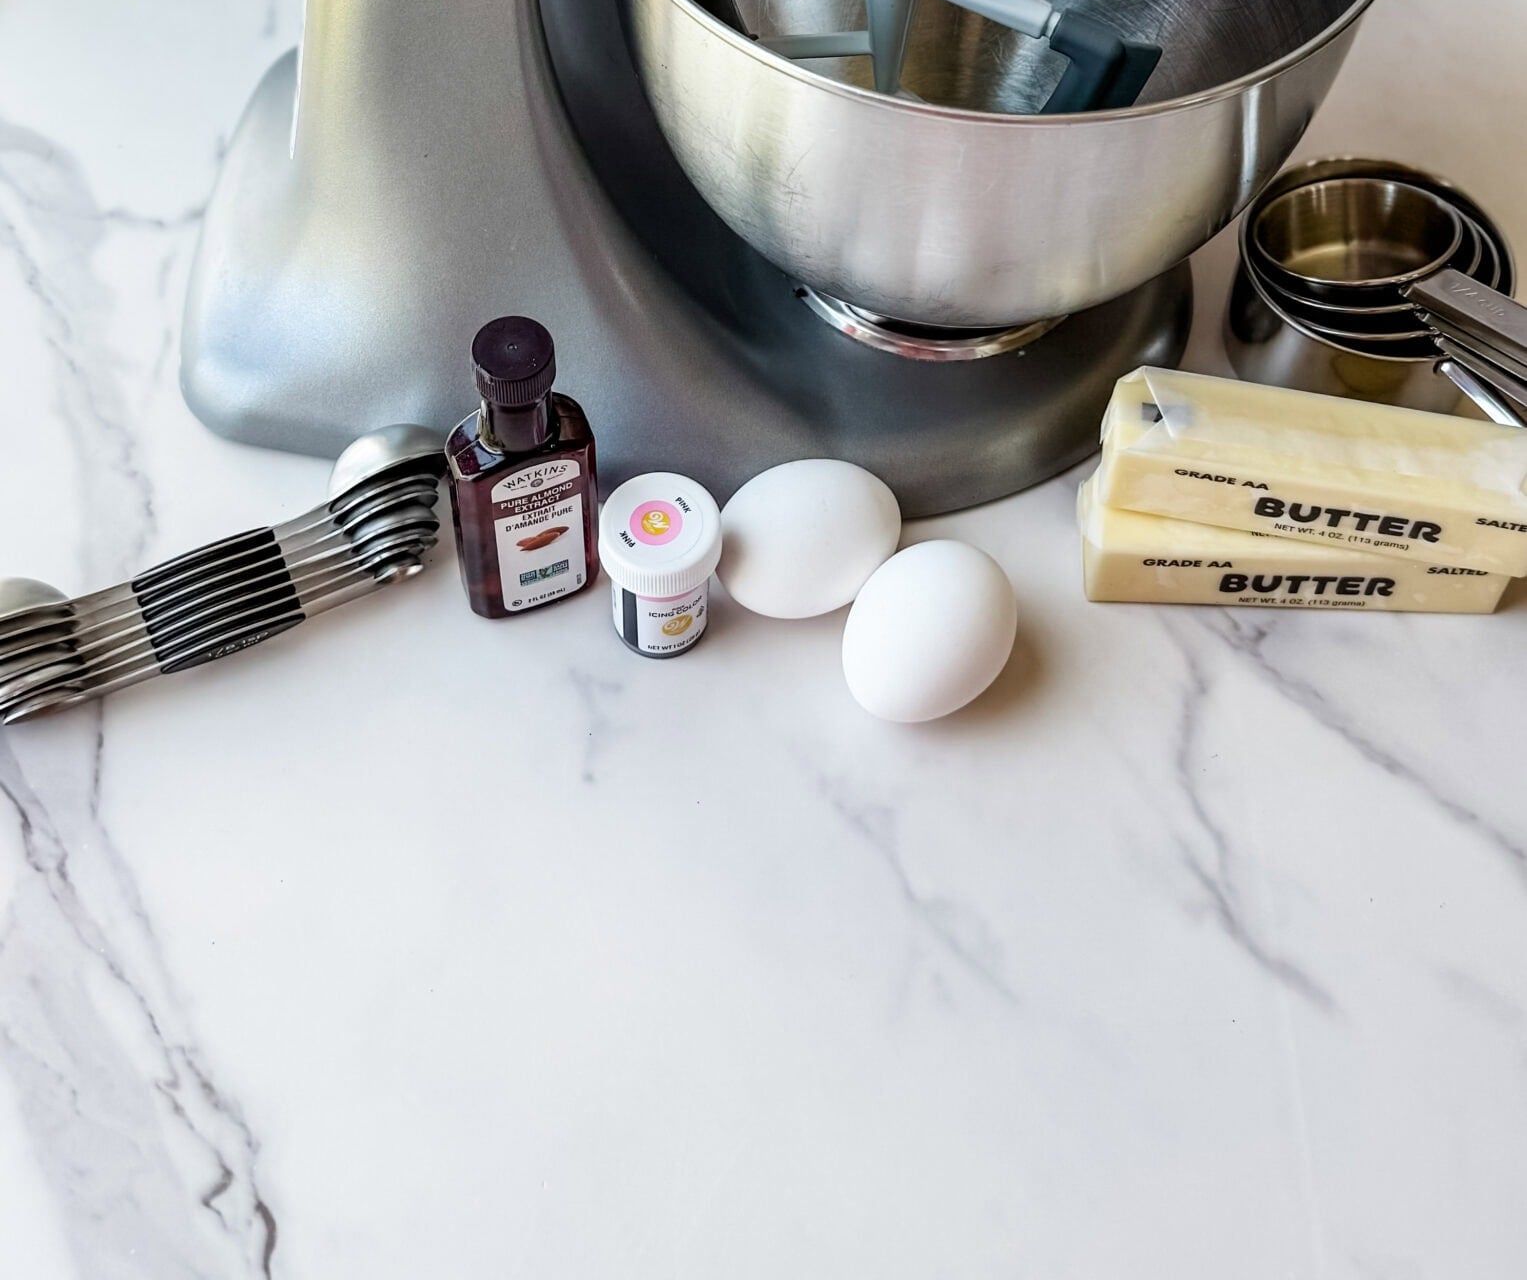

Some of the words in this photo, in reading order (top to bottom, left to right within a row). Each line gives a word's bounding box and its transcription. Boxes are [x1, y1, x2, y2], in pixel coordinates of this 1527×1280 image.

[503, 465, 568, 489] WATKINS
[1174, 468, 1236, 485] GRADE
[1241, 479, 1269, 491] AA
[500, 496, 529, 510] PURE
[530, 481, 573, 502] ALMOND
[515, 493, 561, 513] EXTRACT
[675, 496, 692, 514] PINK
[505, 514, 551, 532] D'AMANDE
[551, 505, 573, 519] PURE
[522, 505, 556, 520] EXTRAIT
[1253, 496, 1442, 544] BUTTER
[619, 530, 636, 548] PINK
[1273, 522, 1295, 533] NET
[1297, 526, 1315, 536] WT.
[1347, 535, 1371, 544] (113
[1373, 539, 1410, 551] grams)
[1142, 558, 1204, 569] GRADE
[1207, 559, 1233, 569] AA
[1427, 566, 1489, 576] SALTED
[1219, 573, 1396, 597] BUTTER
[675, 595, 703, 615] COLOR
[1238, 596, 1257, 604] NET
